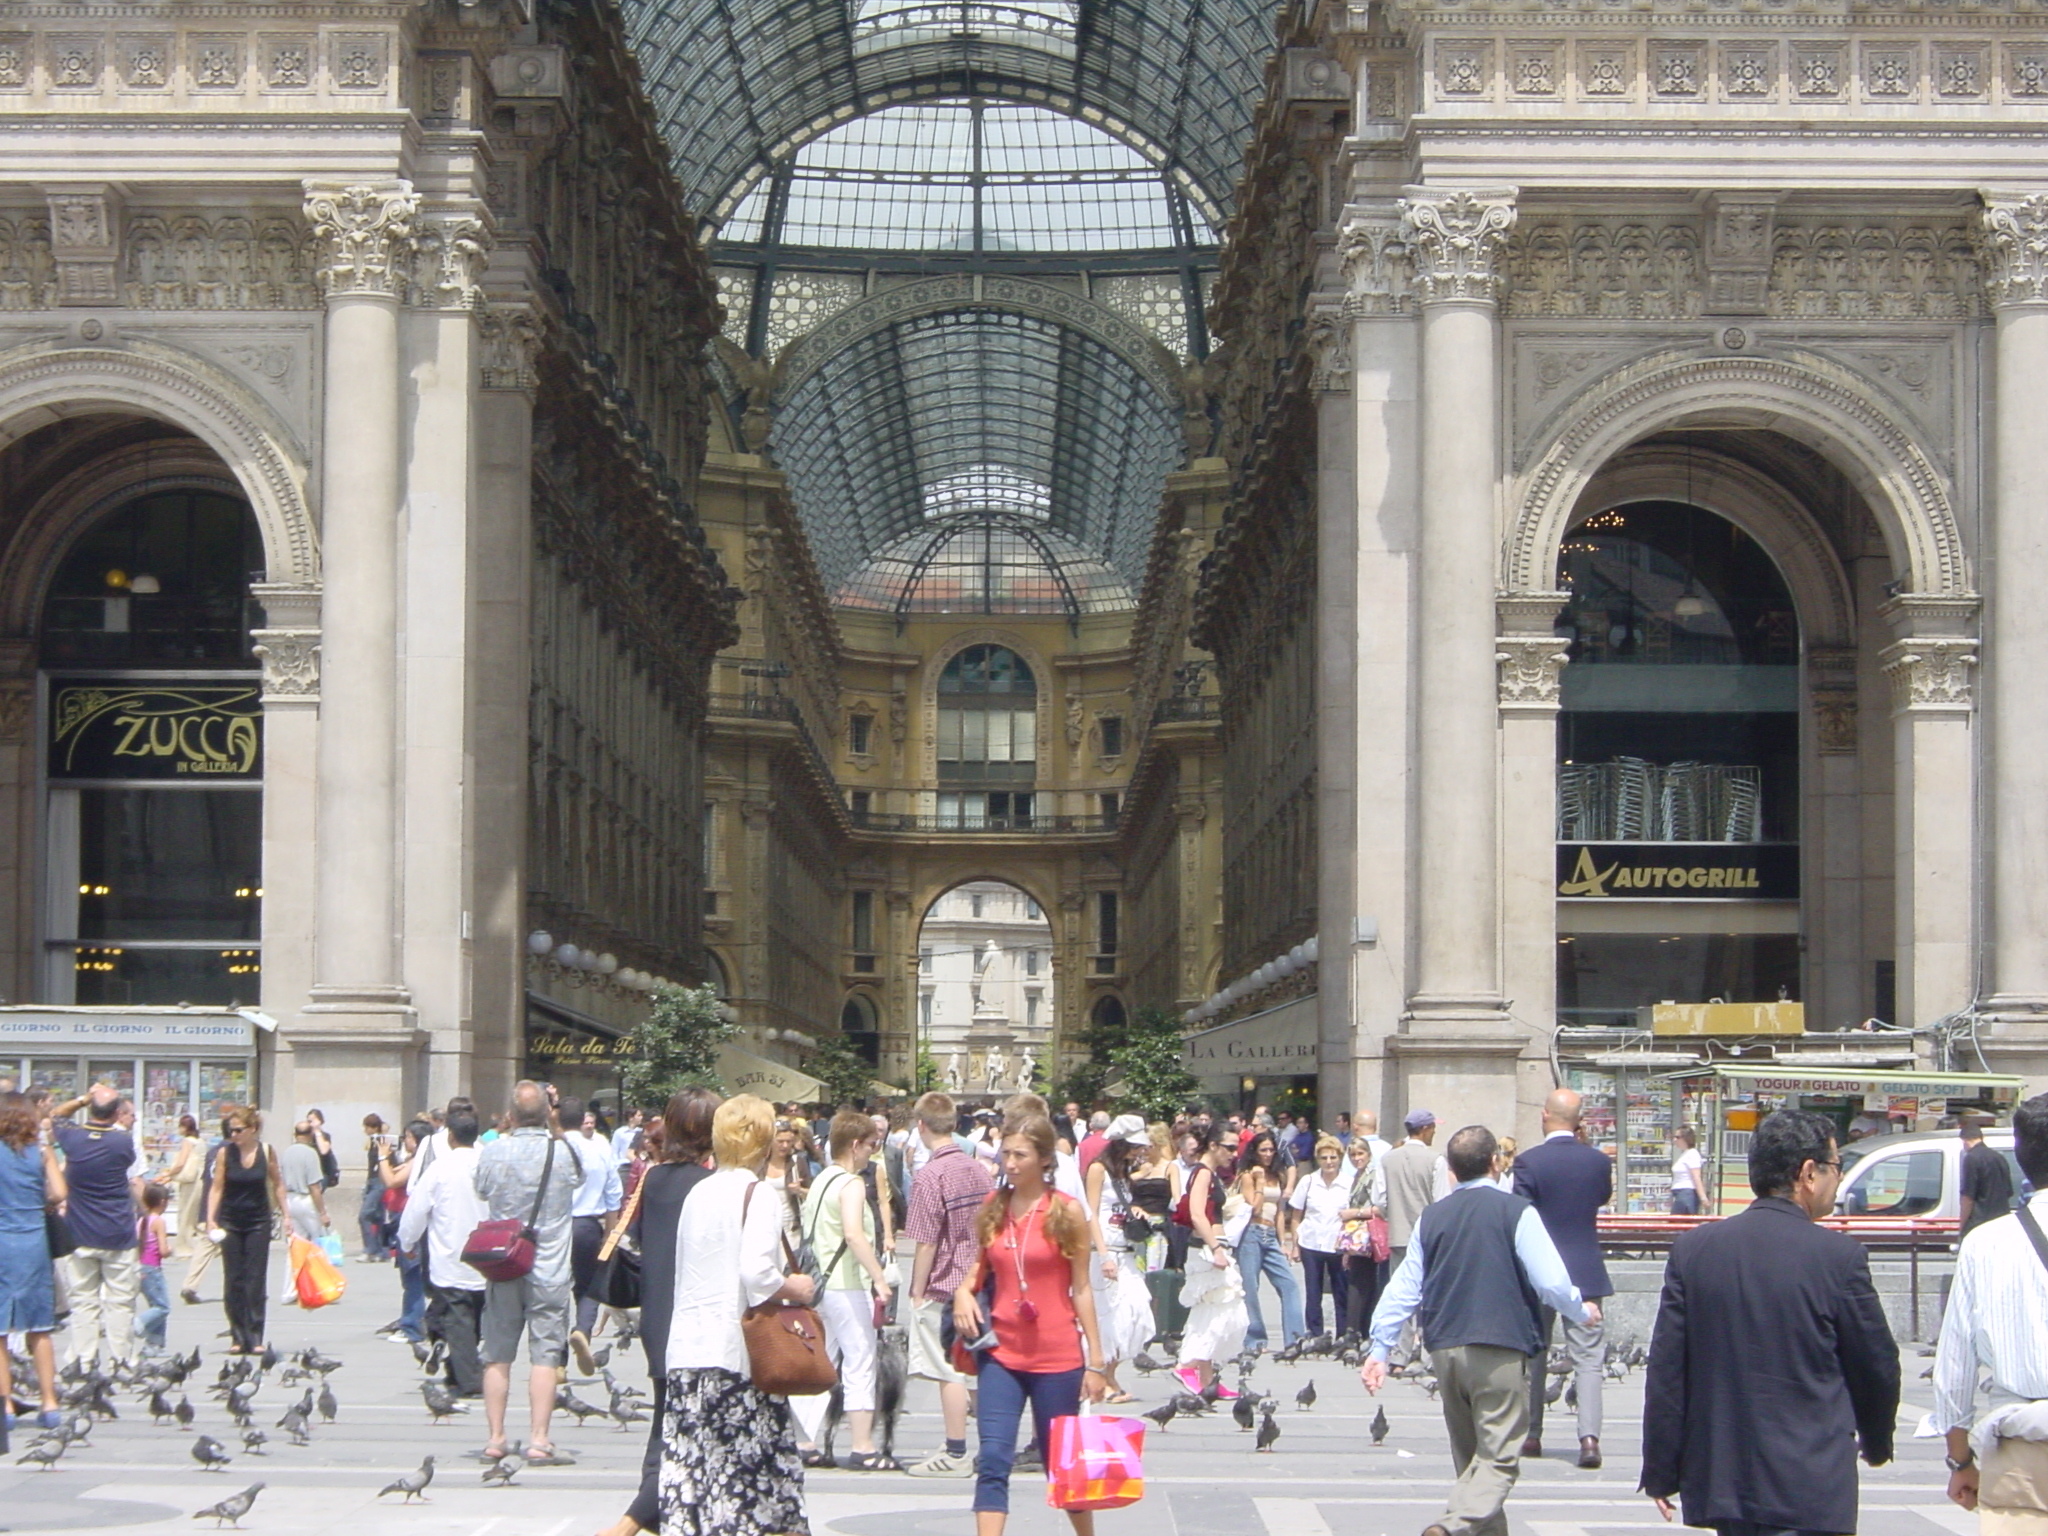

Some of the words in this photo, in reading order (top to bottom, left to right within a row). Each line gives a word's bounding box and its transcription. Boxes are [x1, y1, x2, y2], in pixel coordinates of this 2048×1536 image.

[113, 716, 257, 773] ZUCCA
[177, 761, 187, 772] IN
[1613, 867, 1760, 888] AUTOGRILL
[1, 1023, 61, 1032] GIORNO
[73, 1024, 90, 1033] IL
[93, 1024, 153, 1034] GIORNO
[165, 1025, 184, 1035] IL
[187, 1025, 245, 1036] GIORNO
[580, 1036, 605, 1055] da
[1228, 1041, 1316, 1059] GALLERI
[1812, 1080, 1860, 1092] GELATO
[1882, 1083, 1930, 1094] GELATO
[1934, 1084, 1966, 1095] SOFT
